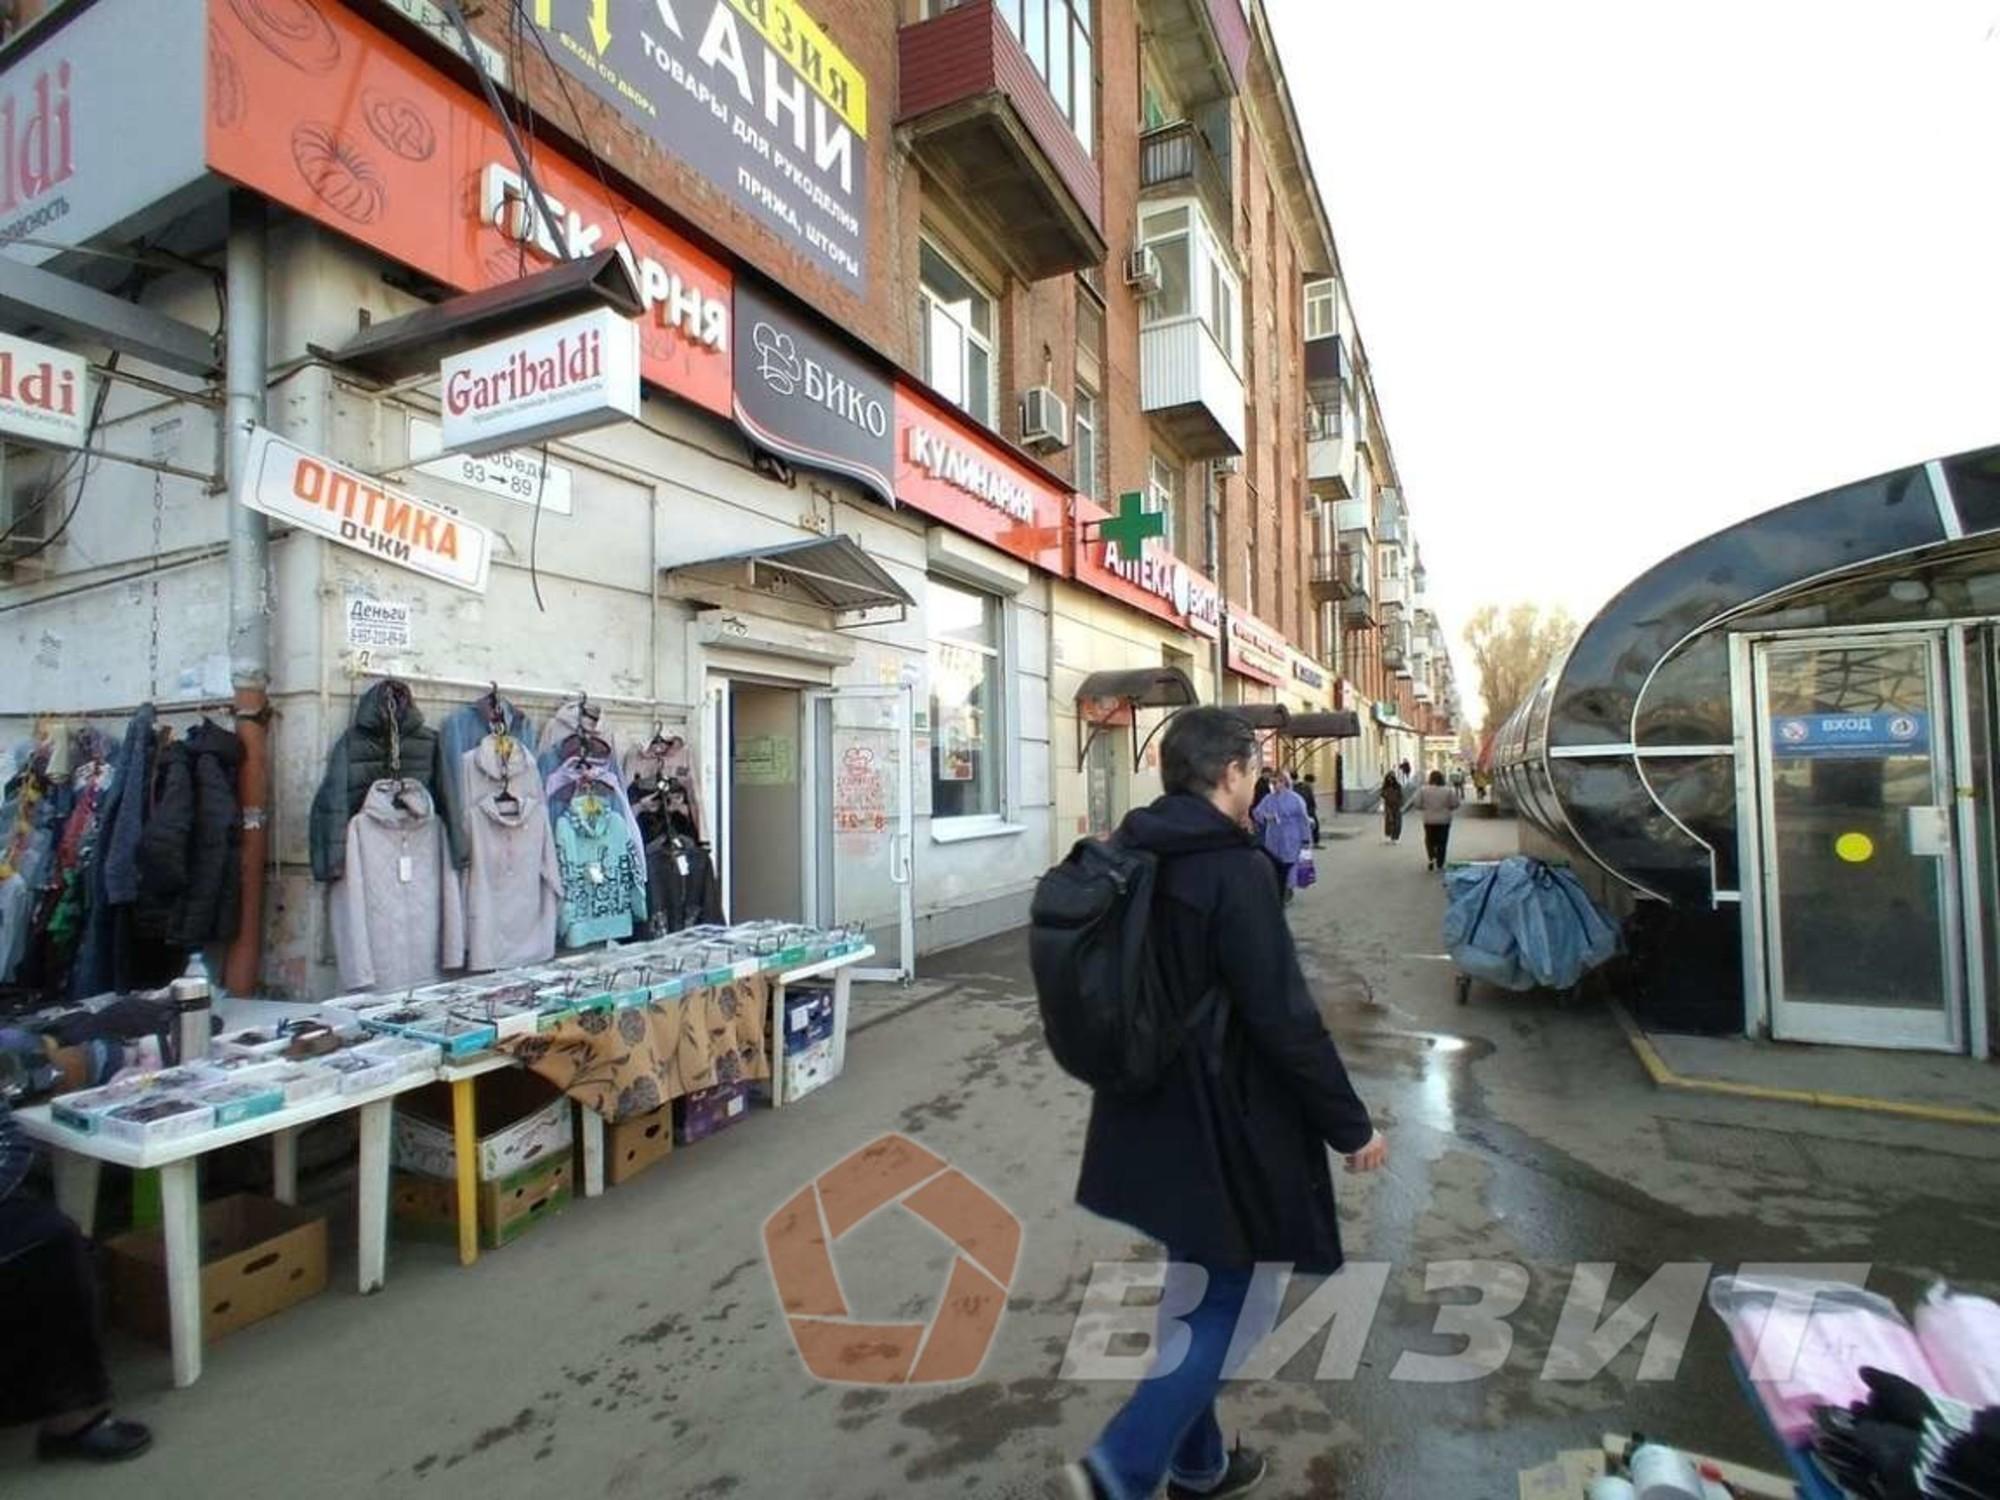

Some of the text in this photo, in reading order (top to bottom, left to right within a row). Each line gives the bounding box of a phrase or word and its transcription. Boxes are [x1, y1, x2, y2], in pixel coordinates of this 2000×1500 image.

[640, 31, 859, 237] ТОВАРЫ ДЛЯ РУКОДЕЛИЯ
[806, 223, 859, 277] ШТОРЫ
[448, 329, 600, 415] Garibaldi
[803, 359, 886, 439] БИКО
[462, 461, 533, 497] 93 89
[486, 450, 551, 480] обеды
[911, 429, 1032, 521] КУЛИНАРИЯ
[293, 457, 459, 560] ОПТИКА
[340, 520, 410, 561] ОЧКИ
[350, 600, 406, 621] Деньги
[1821, 717, 1873, 733] ВХОД
